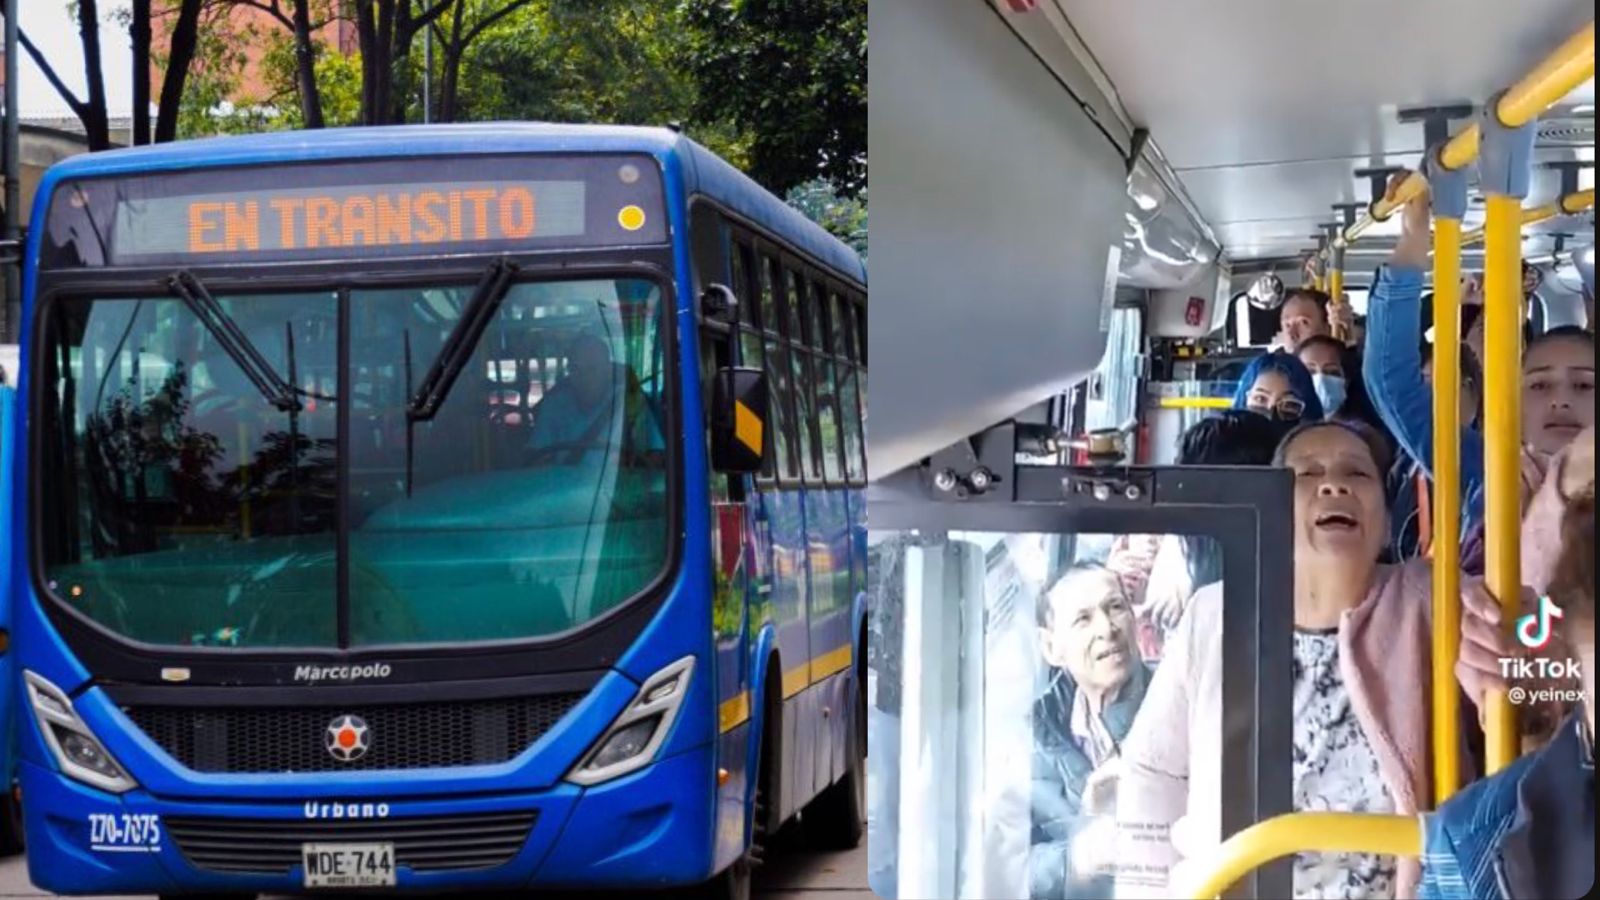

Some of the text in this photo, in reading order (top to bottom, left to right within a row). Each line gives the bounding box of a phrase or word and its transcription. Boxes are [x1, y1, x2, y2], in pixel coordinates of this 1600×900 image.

[188, 187, 535, 253] EN TRANSITO
[294, 663, 391, 681] Marcopolo
[304, 802, 390, 818] Urbano
